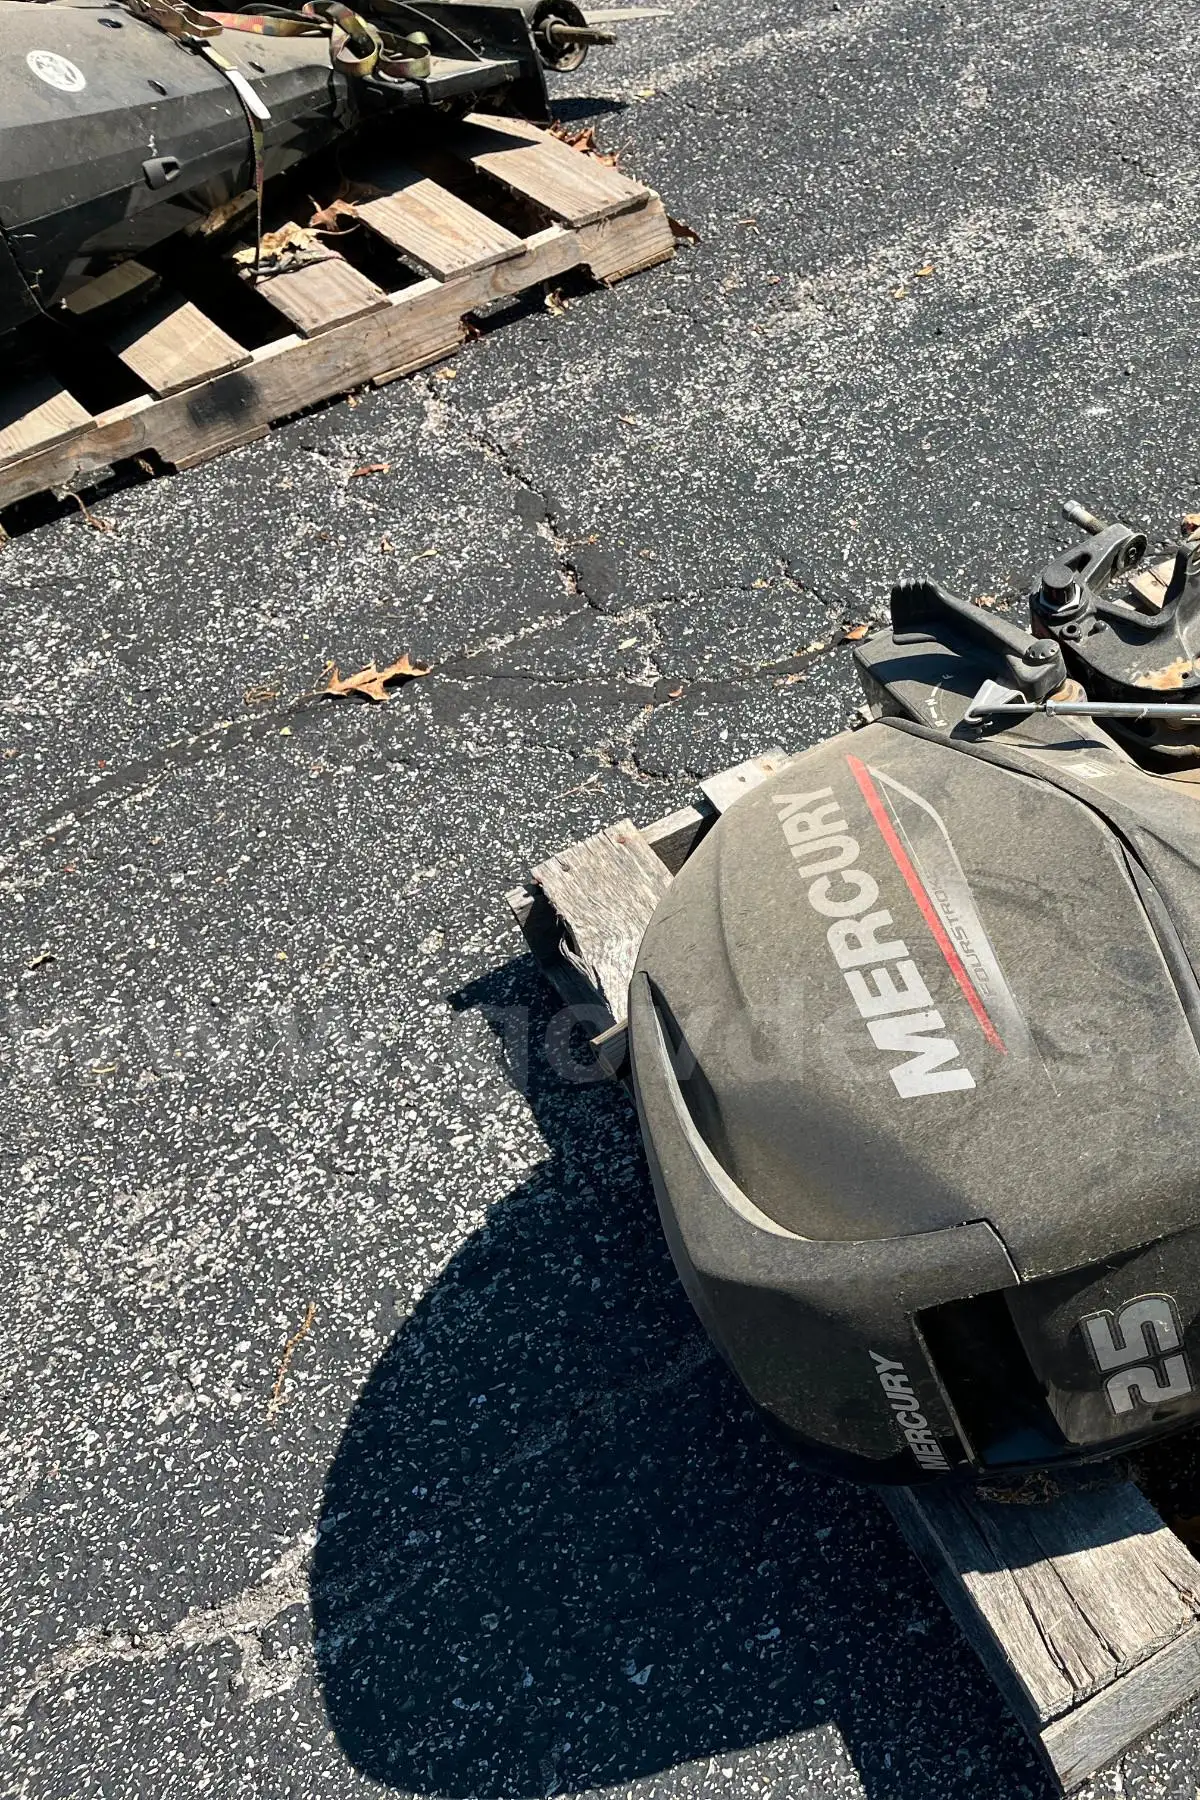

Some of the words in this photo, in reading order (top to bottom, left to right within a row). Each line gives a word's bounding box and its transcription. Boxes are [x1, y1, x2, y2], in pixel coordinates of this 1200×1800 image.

[772, 786, 976, 1098] MERCURY
[926, 872, 994, 998] FOURSTROK
[868, 1349, 951, 1470] MERCURY
[1082, 1295, 1193, 1415] 25
